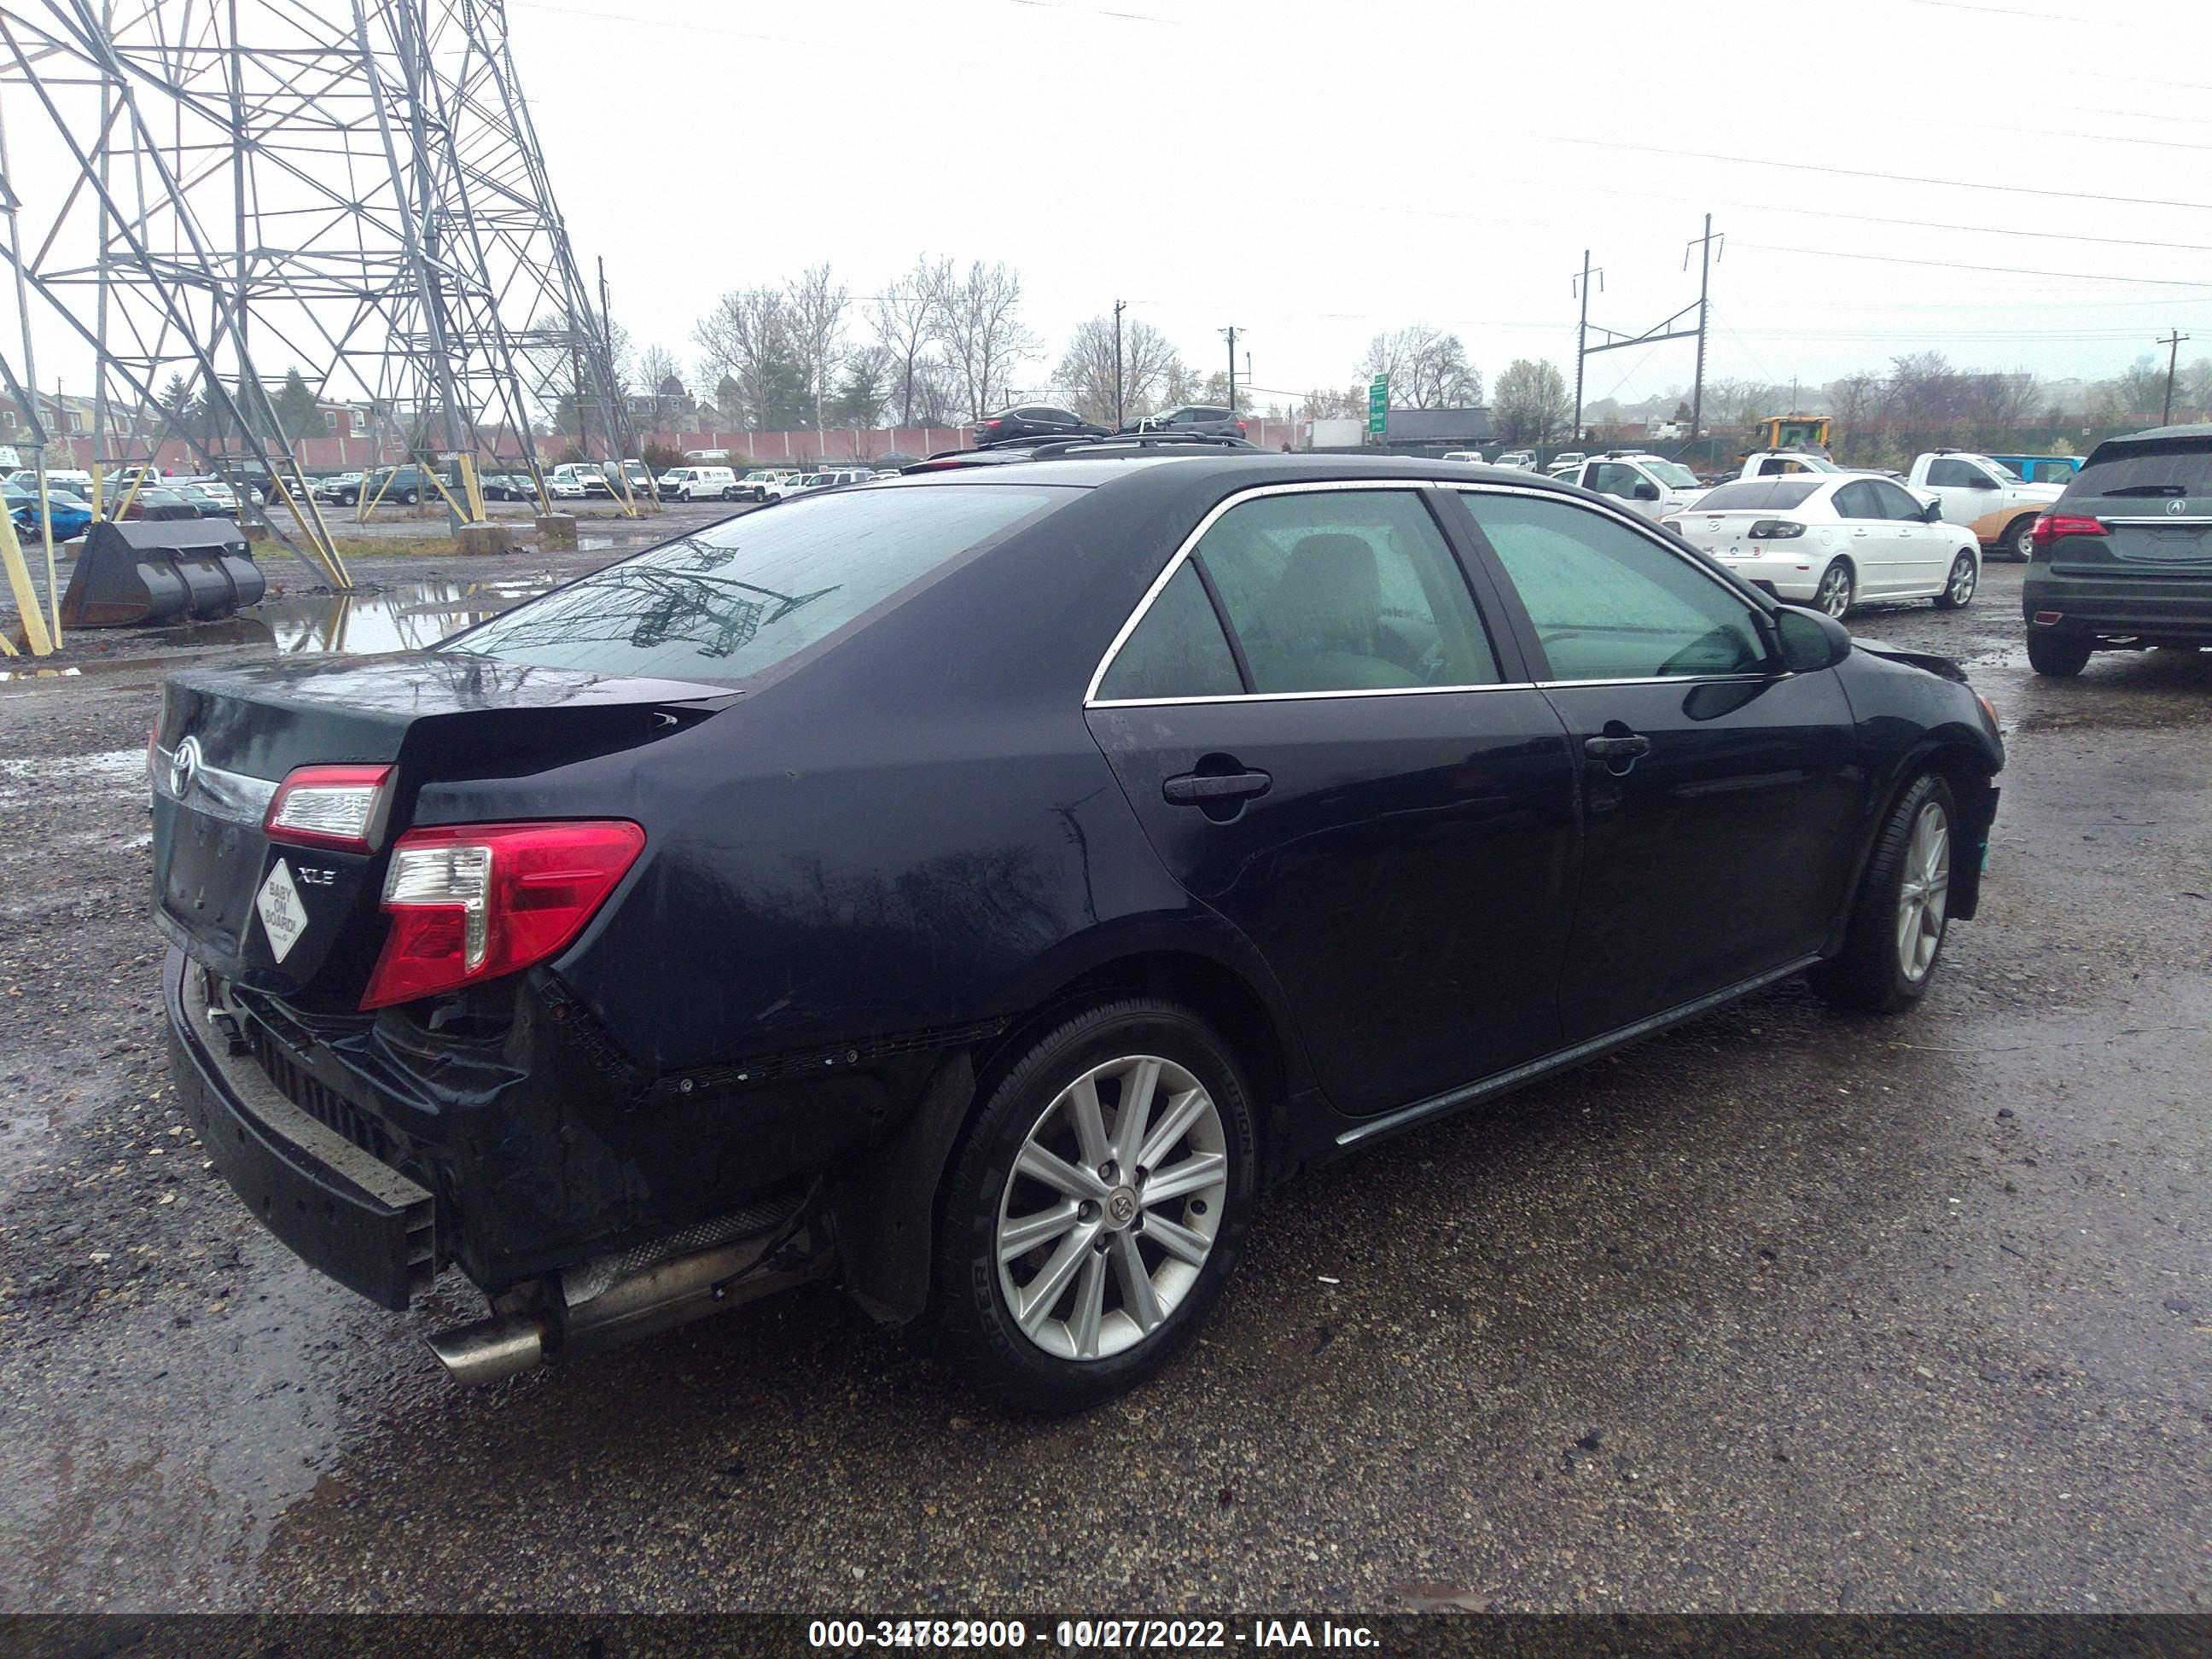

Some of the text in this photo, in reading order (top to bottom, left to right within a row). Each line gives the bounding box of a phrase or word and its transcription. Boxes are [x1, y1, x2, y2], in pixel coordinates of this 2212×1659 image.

[295, 867, 336, 884] XLE
[269, 881, 292, 903] BABY
[274, 898, 287, 916] ON
[265, 908, 297, 934] BOARD!
